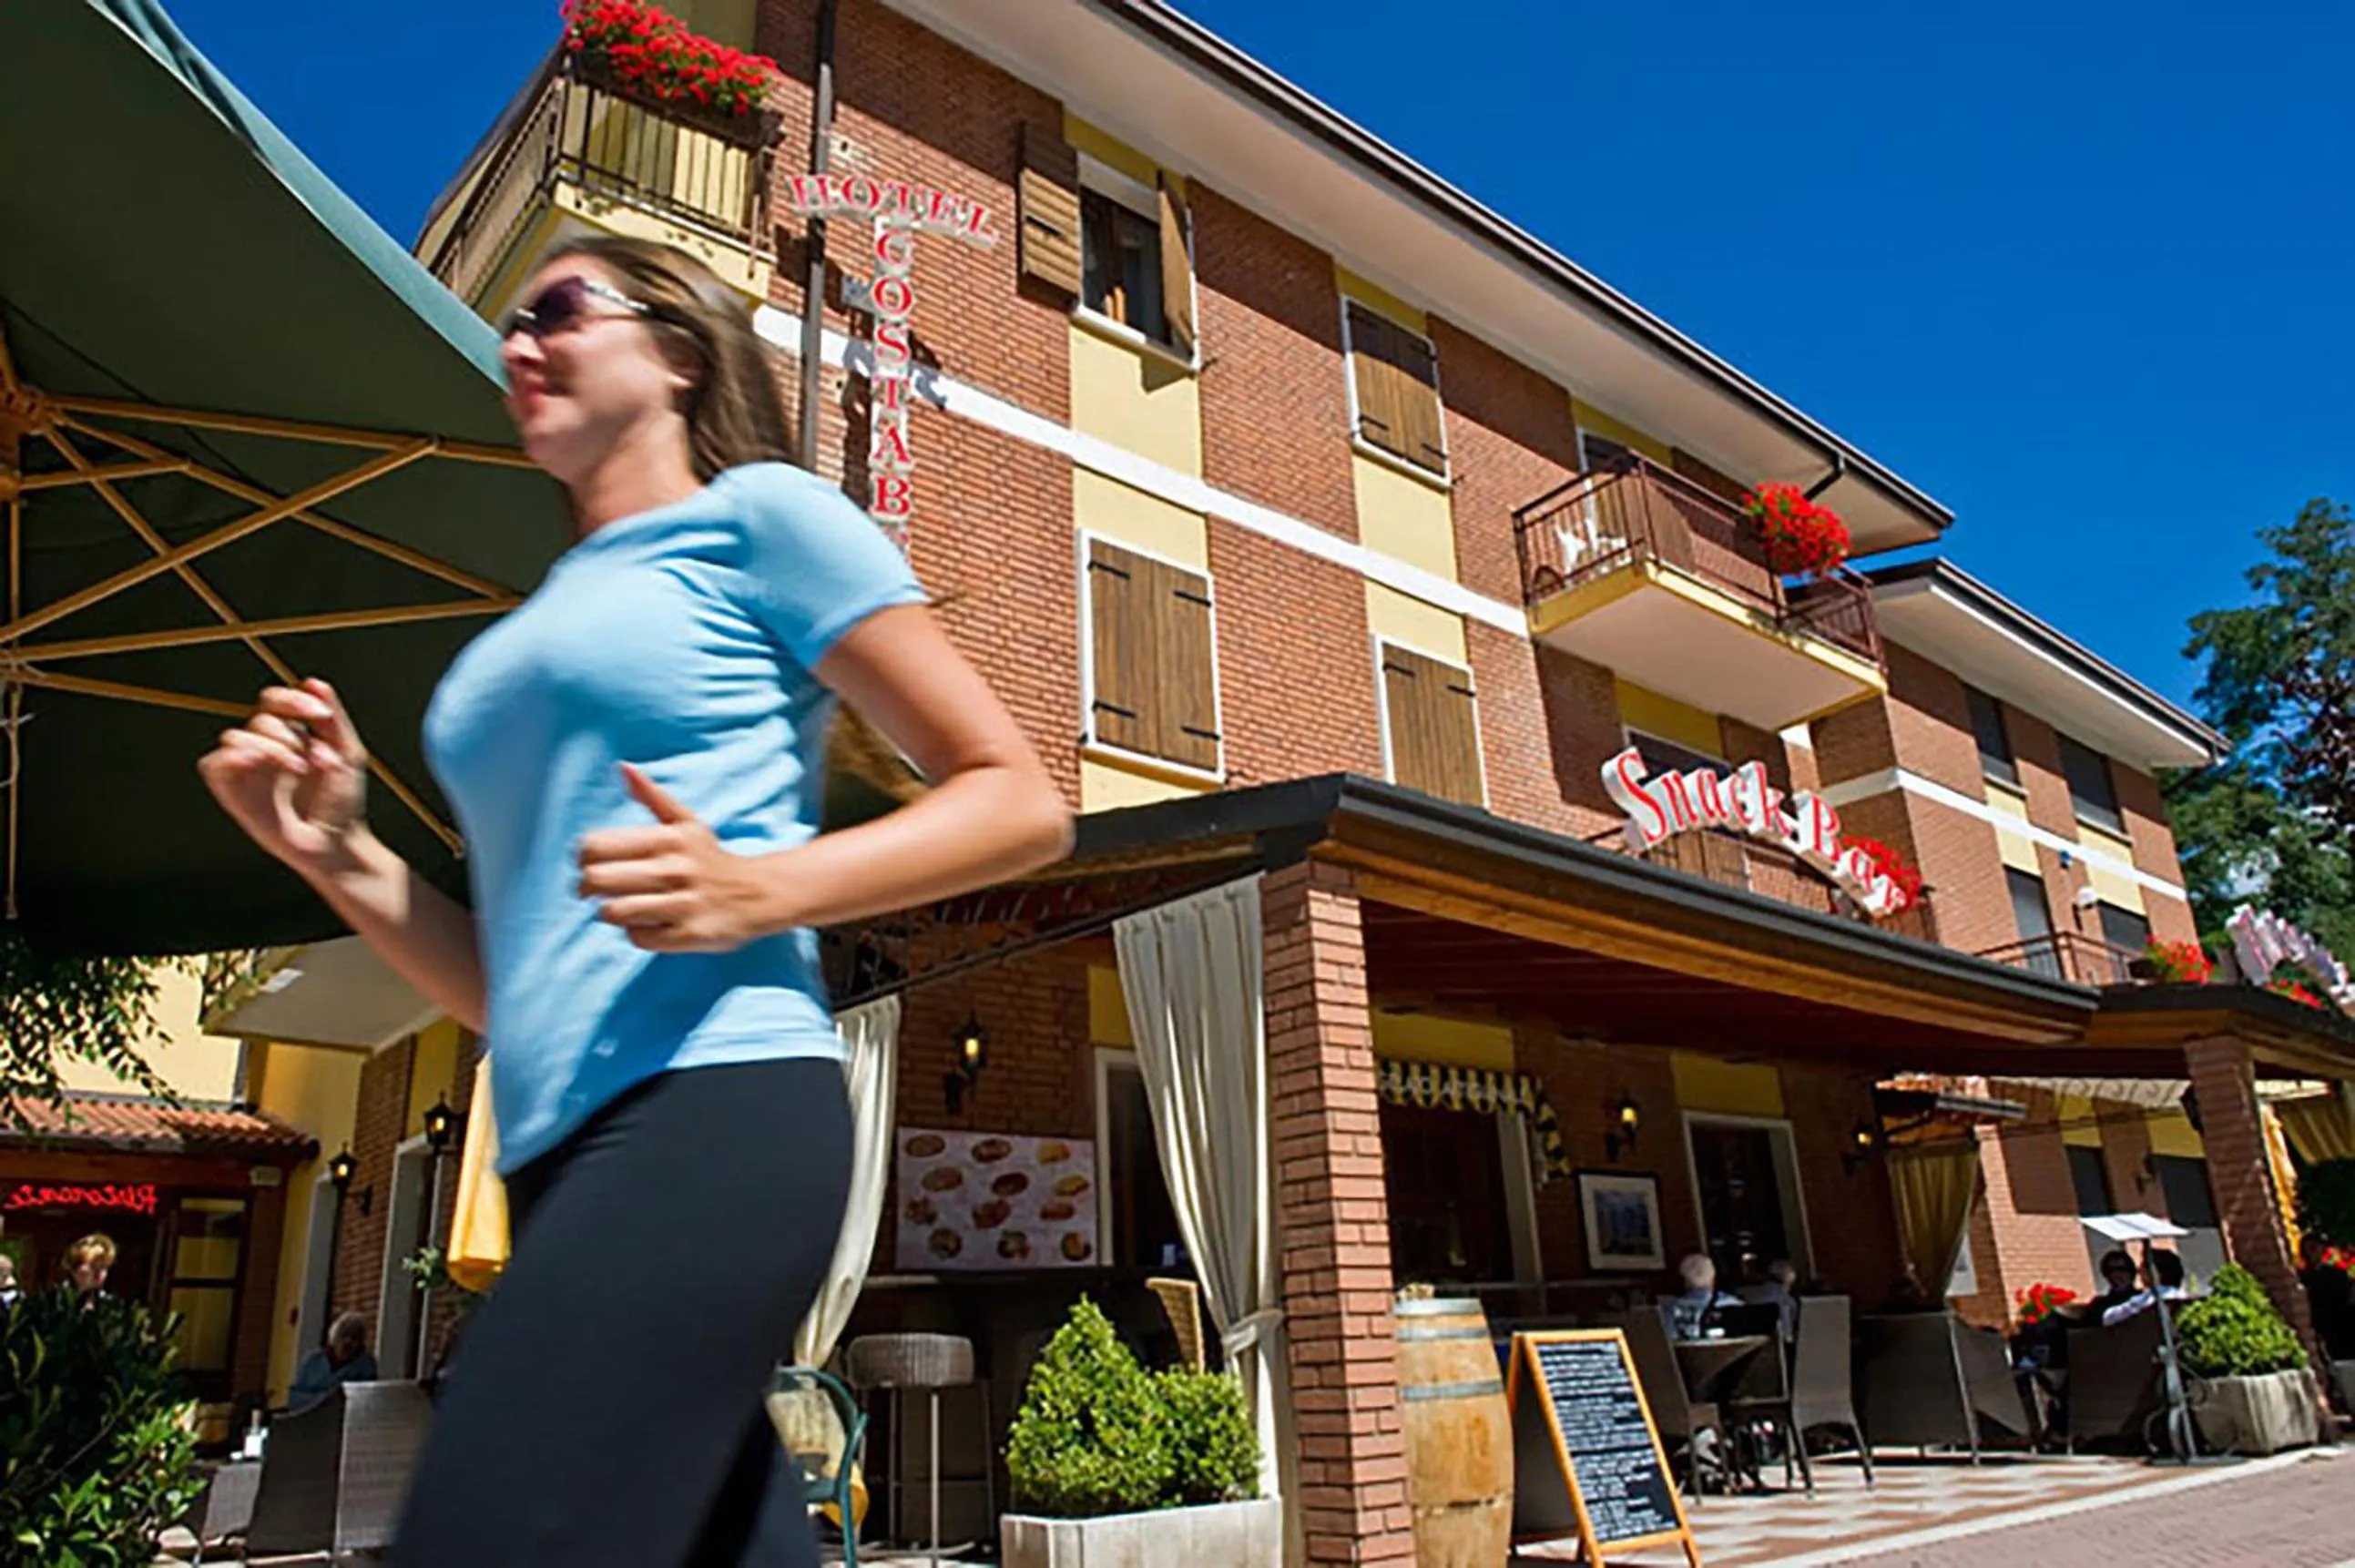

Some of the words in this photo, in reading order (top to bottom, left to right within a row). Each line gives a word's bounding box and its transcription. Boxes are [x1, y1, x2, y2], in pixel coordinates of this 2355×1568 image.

[786, 173, 997, 246] HOTEL
[1605, 748, 1792, 847] Snack
[1807, 790, 1908, 911] Bar
